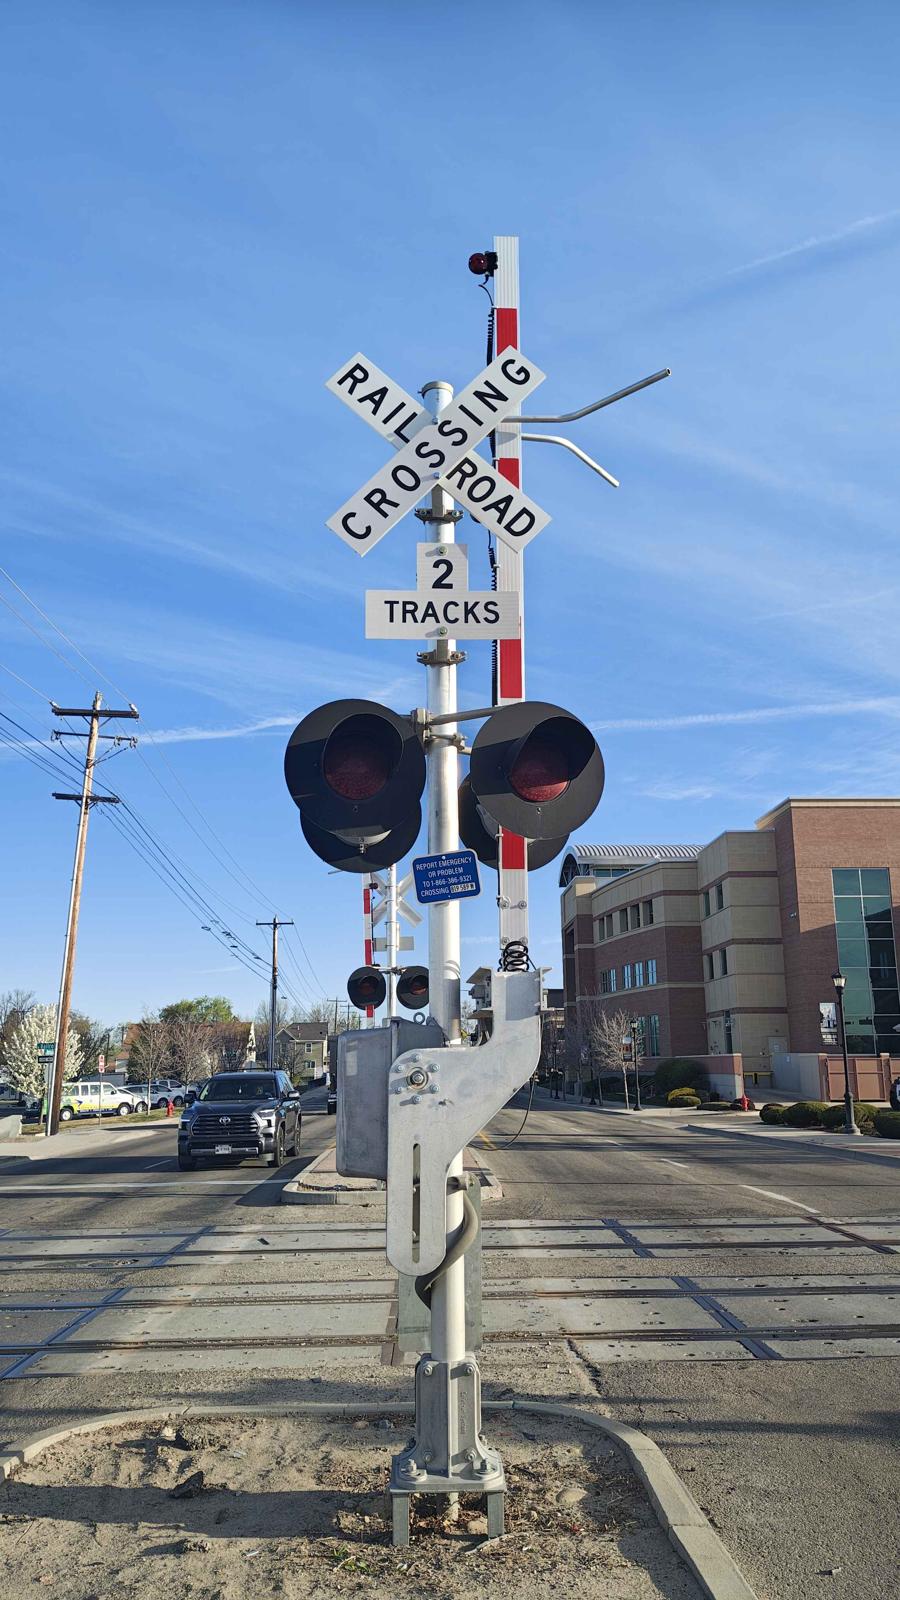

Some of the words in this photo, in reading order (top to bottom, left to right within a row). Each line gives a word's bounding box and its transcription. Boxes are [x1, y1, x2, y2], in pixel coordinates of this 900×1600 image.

[337, 362, 418, 444] RAIL
[445, 457, 535, 537] ROAD
[341, 359, 531, 540] CROSSING
[431, 559, 454, 589] 2
[384, 600, 500, 624] TRACKS
[416, 862, 437, 870] REPORT
[438, 857, 472, 867] EMERGENCY
[437, 867, 464, 877] PROBLEM
[420, 887, 450, 897] CROSSING
